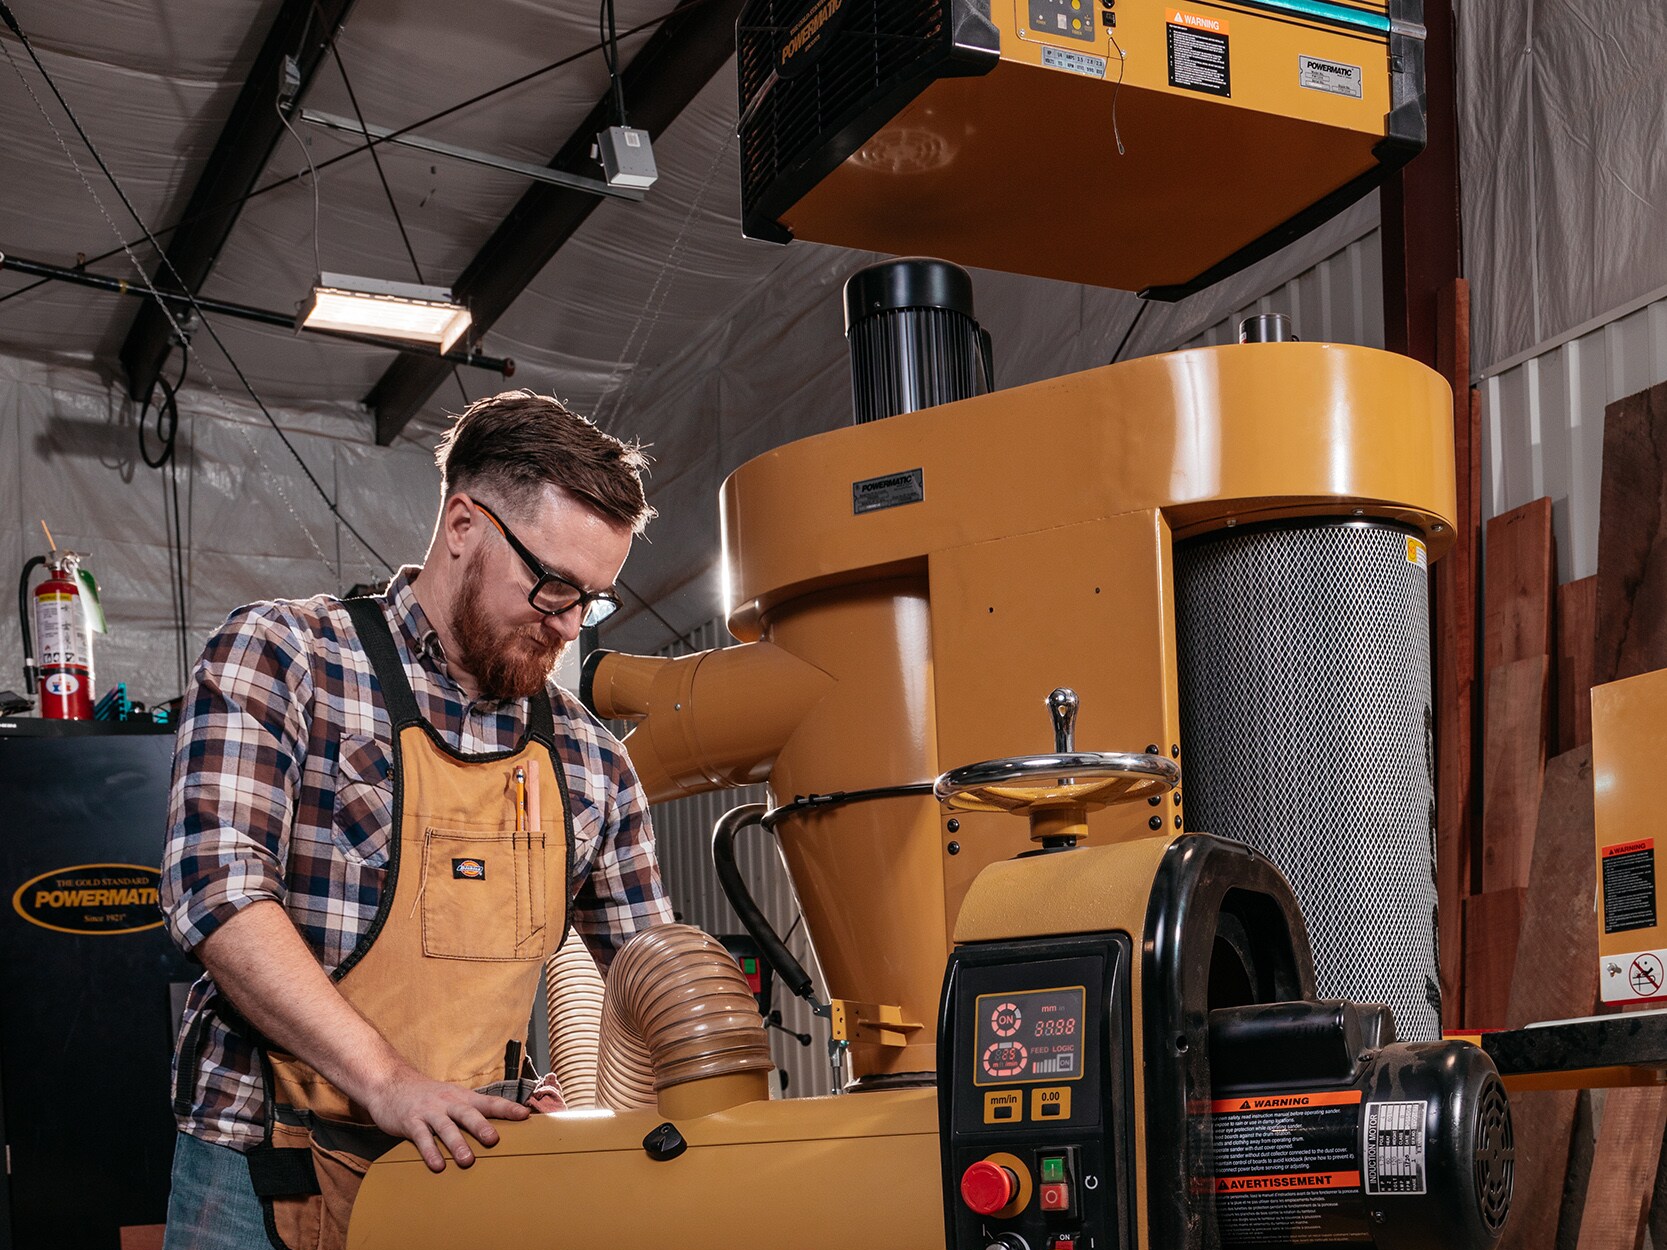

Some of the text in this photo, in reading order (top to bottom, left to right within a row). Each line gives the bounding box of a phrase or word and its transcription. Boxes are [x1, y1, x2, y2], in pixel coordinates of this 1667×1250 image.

[1184, 14, 1220, 30] WARNING
[1307, 61, 1352, 76] POWERMATIC
[862, 475, 912, 492] POWERMATIC
[1614, 843, 1646, 854] WARNING
[102, 877, 149, 885] STANDARD
[999, 1015, 1014, 1025] ON
[991, 1095, 1017, 1104] mm/in
[1041, 1092, 1060, 1101] 0.00
[1254, 1097, 1310, 1108] WARNING
[1369, 1114, 1377, 1140] MOTOR
[1230, 1176, 1332, 1190] AVERTISSEMENT
